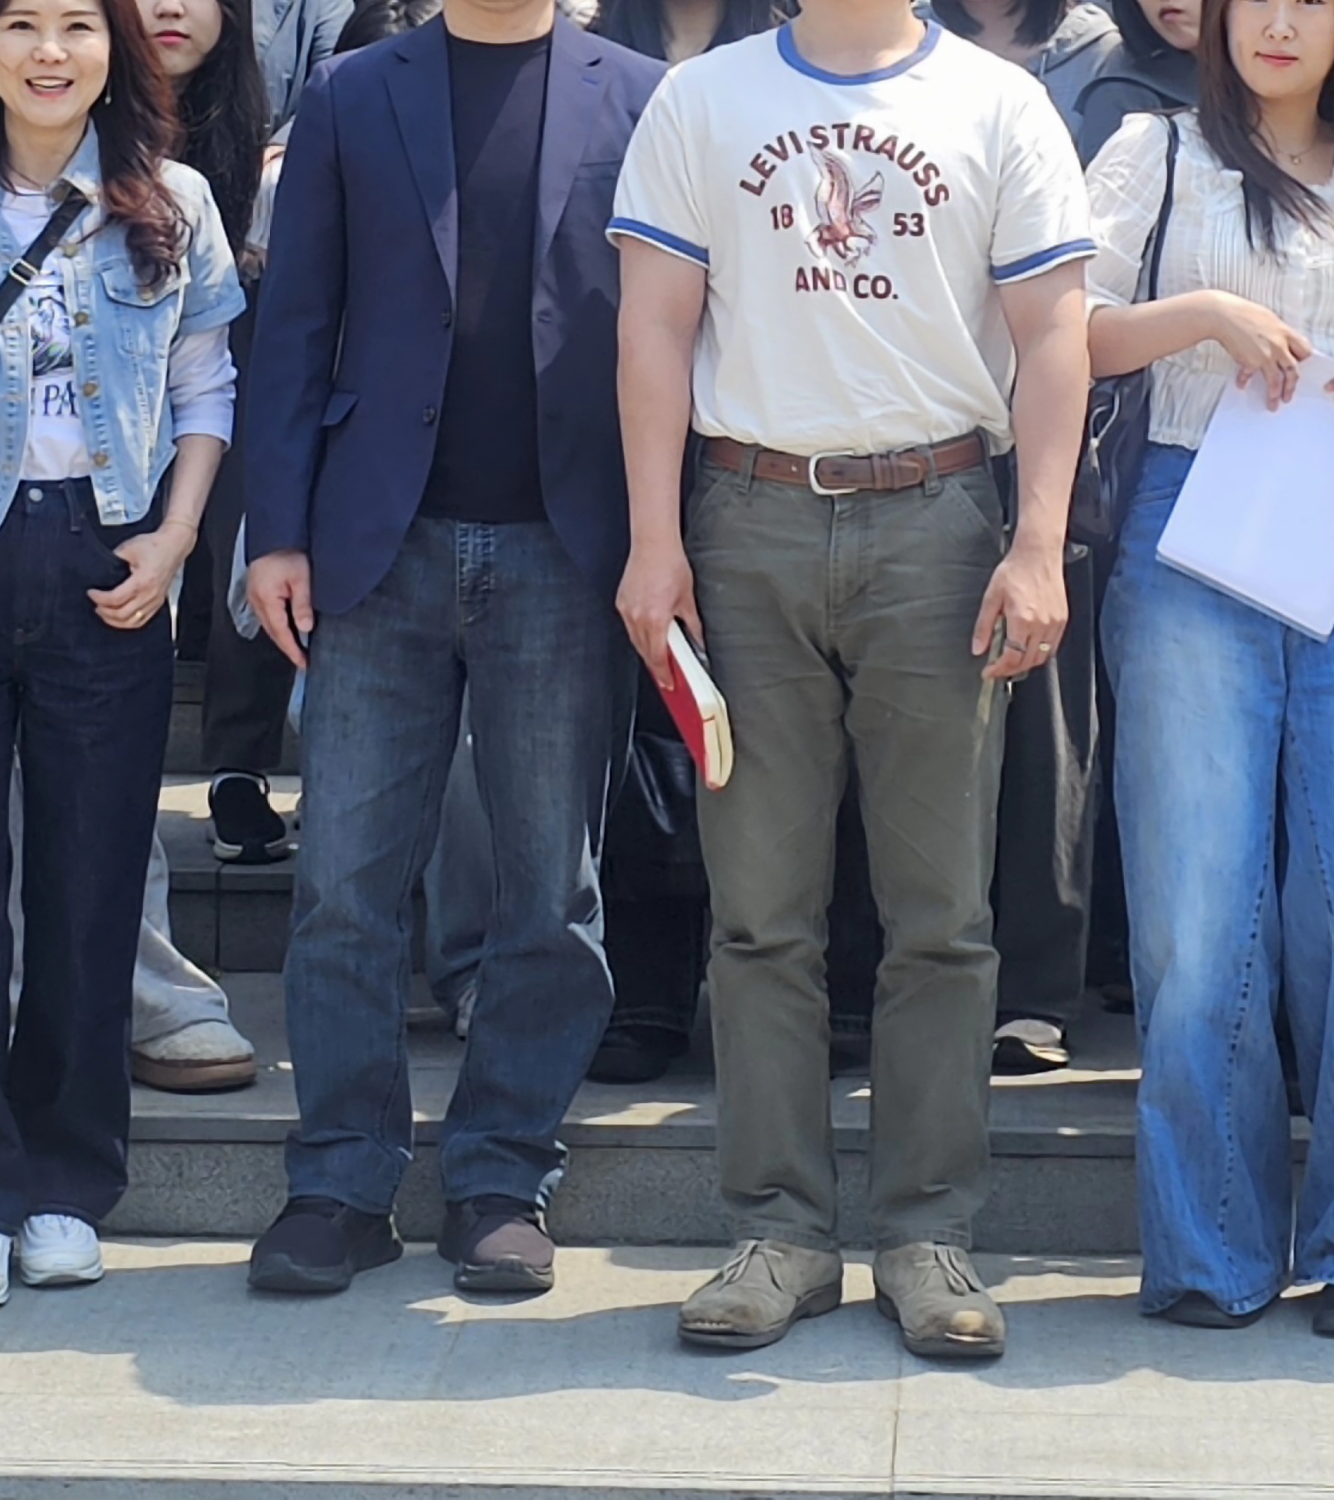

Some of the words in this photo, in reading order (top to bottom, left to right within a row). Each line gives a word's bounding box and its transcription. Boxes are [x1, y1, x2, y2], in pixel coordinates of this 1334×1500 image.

[739, 130, 804, 197] LEVI
[809, 122, 950, 207] STRAUSS
[770, 203, 795, 230] 18
[892, 212, 925, 237] 53
[795, 265, 847, 292] AND
[853, 273, 899, 300] CO.
